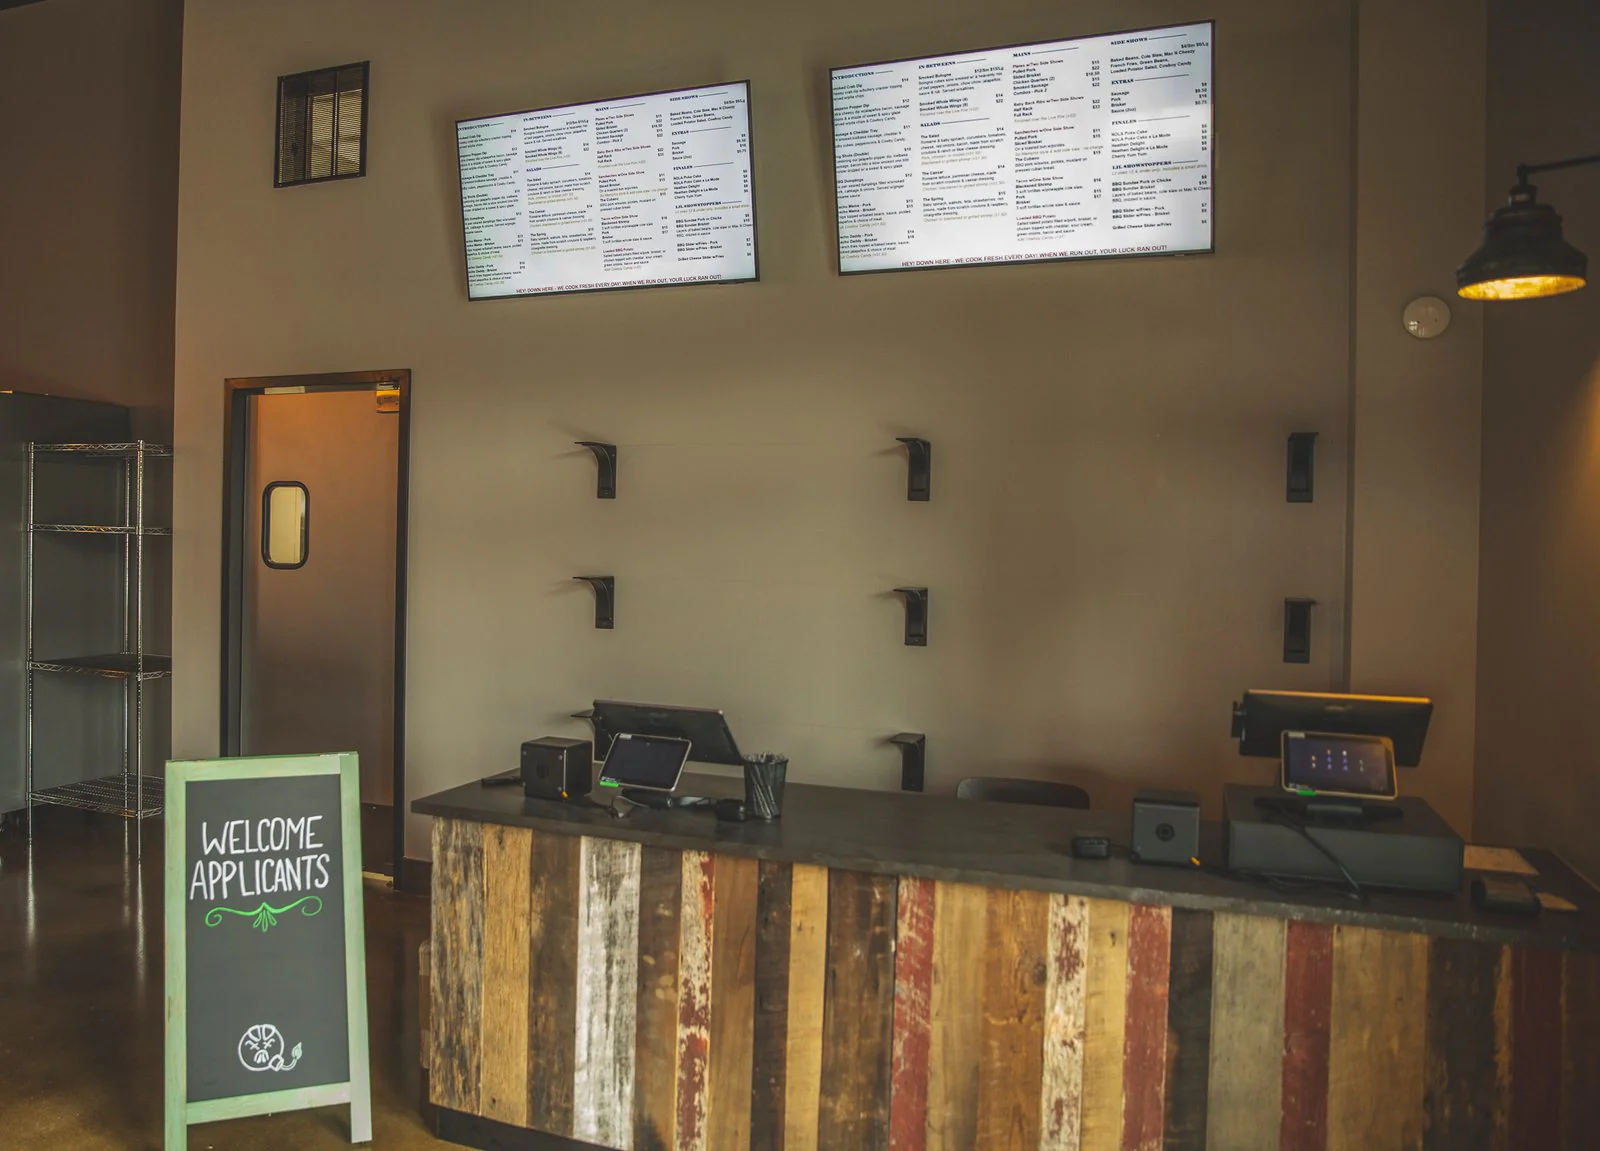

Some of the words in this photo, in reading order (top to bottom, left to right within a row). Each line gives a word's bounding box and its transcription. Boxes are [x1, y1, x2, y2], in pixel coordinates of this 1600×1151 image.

[1123, 160, 1171, 168] SHOWSTOPPERS
[202, 815, 323, 856] WELCOME
[190, 853, 330, 900] APPLICANTS
